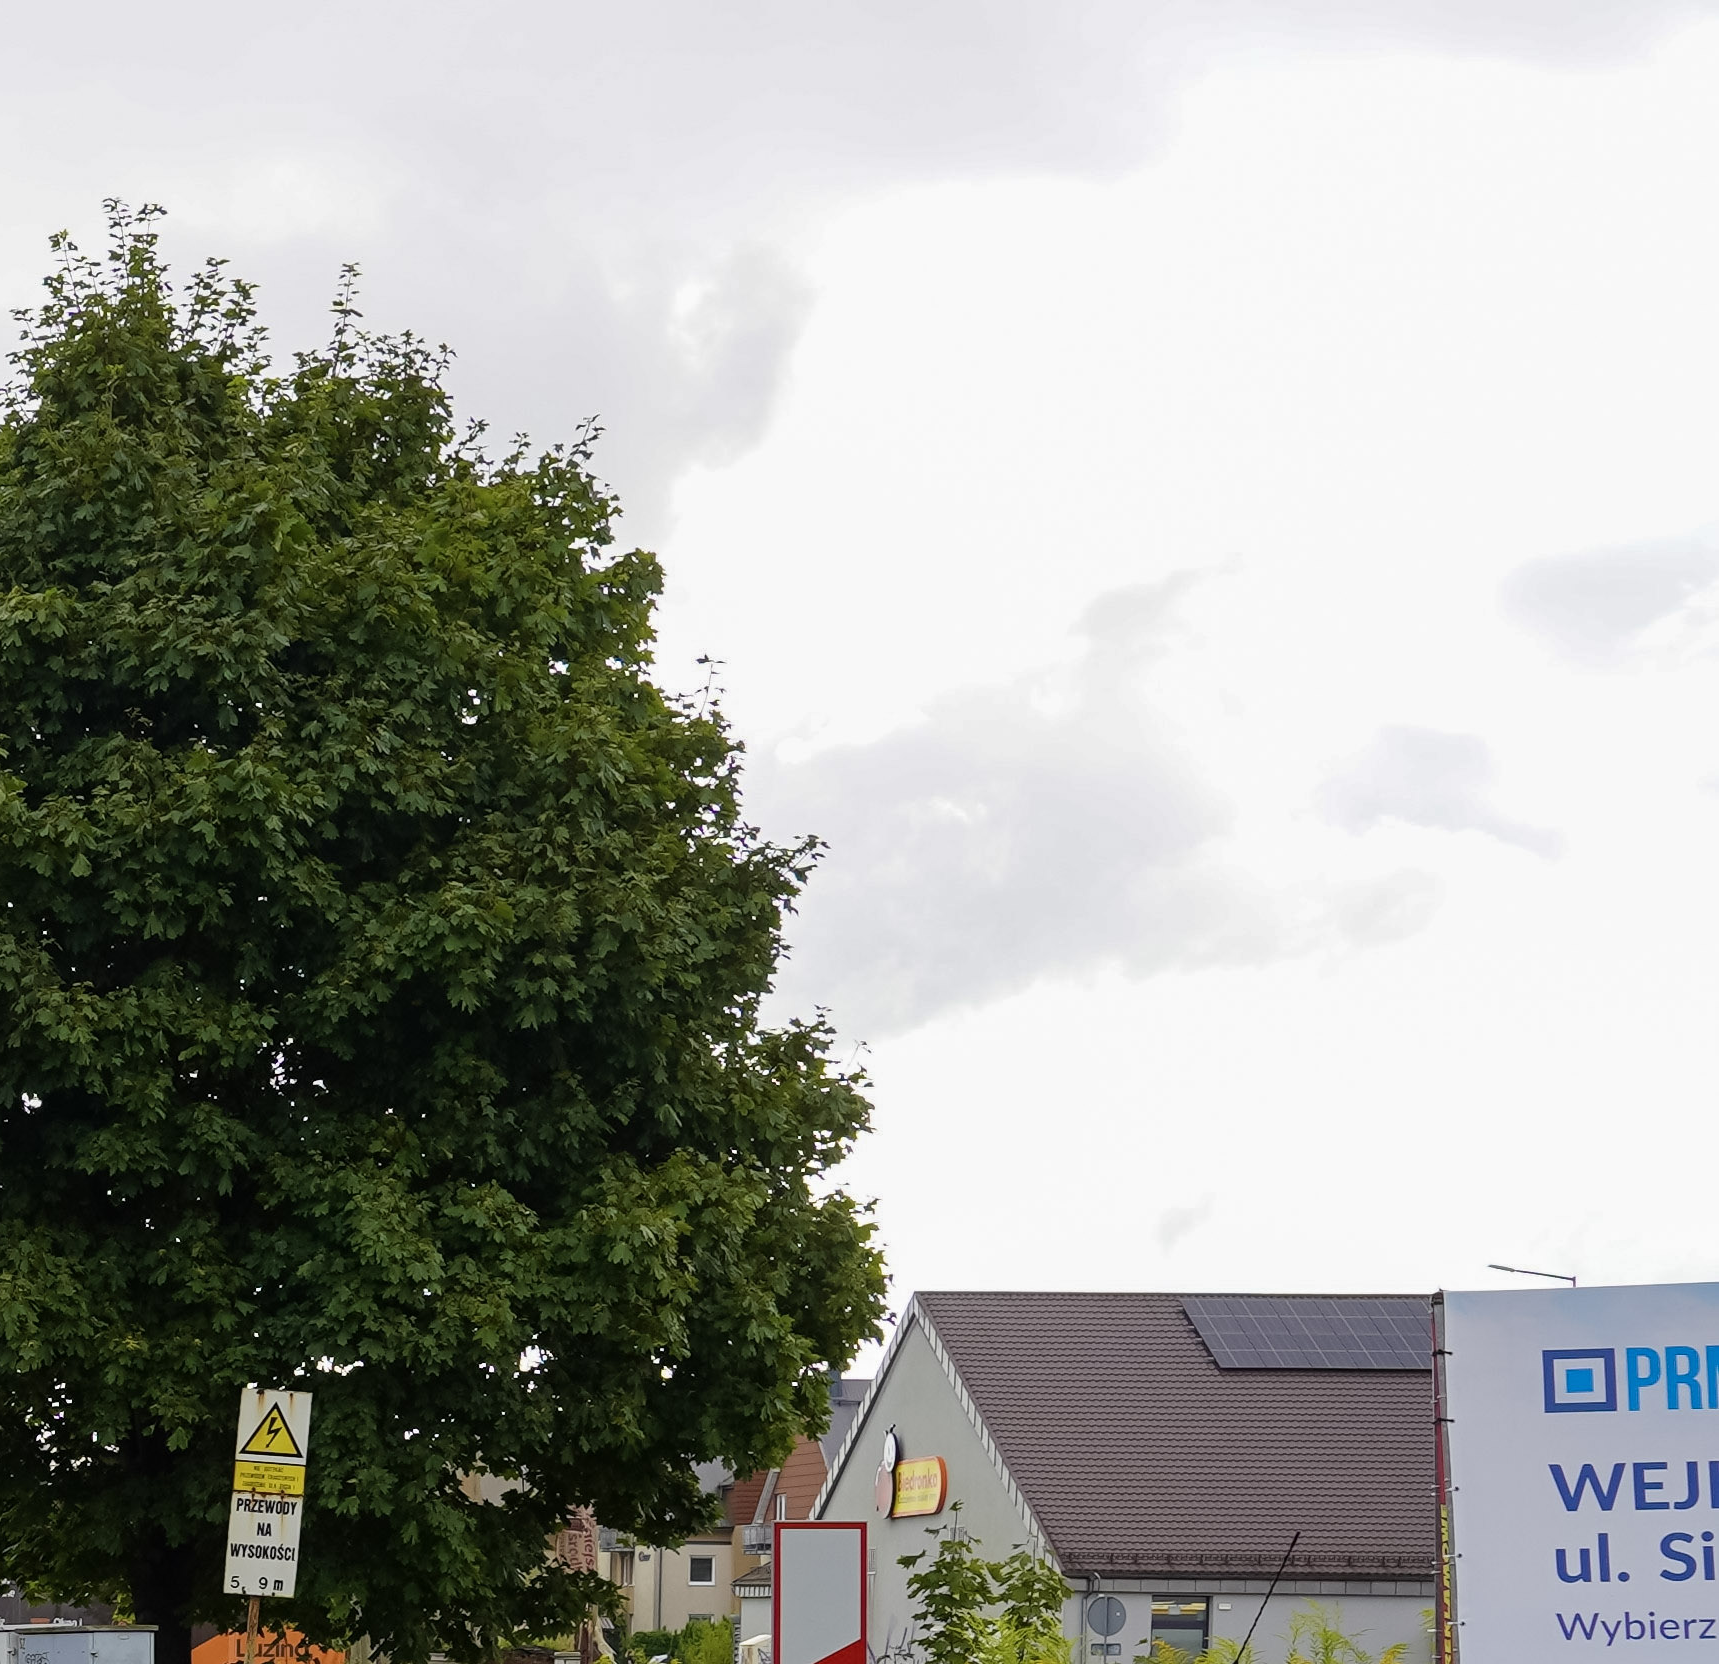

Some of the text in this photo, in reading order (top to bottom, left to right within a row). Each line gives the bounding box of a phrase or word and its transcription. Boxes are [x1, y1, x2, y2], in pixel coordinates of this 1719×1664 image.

[1548, 1460, 1719, 1512] WEJ
[236, 1498, 298, 1516] PRZEWODY
[256, 1522, 272, 1537] NA
[230, 1543, 296, 1562] WYSOKOŚCI
[1555, 1532, 1630, 1583] ul.
[274, 1580, 284, 1592] m
[1556, 1611, 1718, 1647] Wybierz
